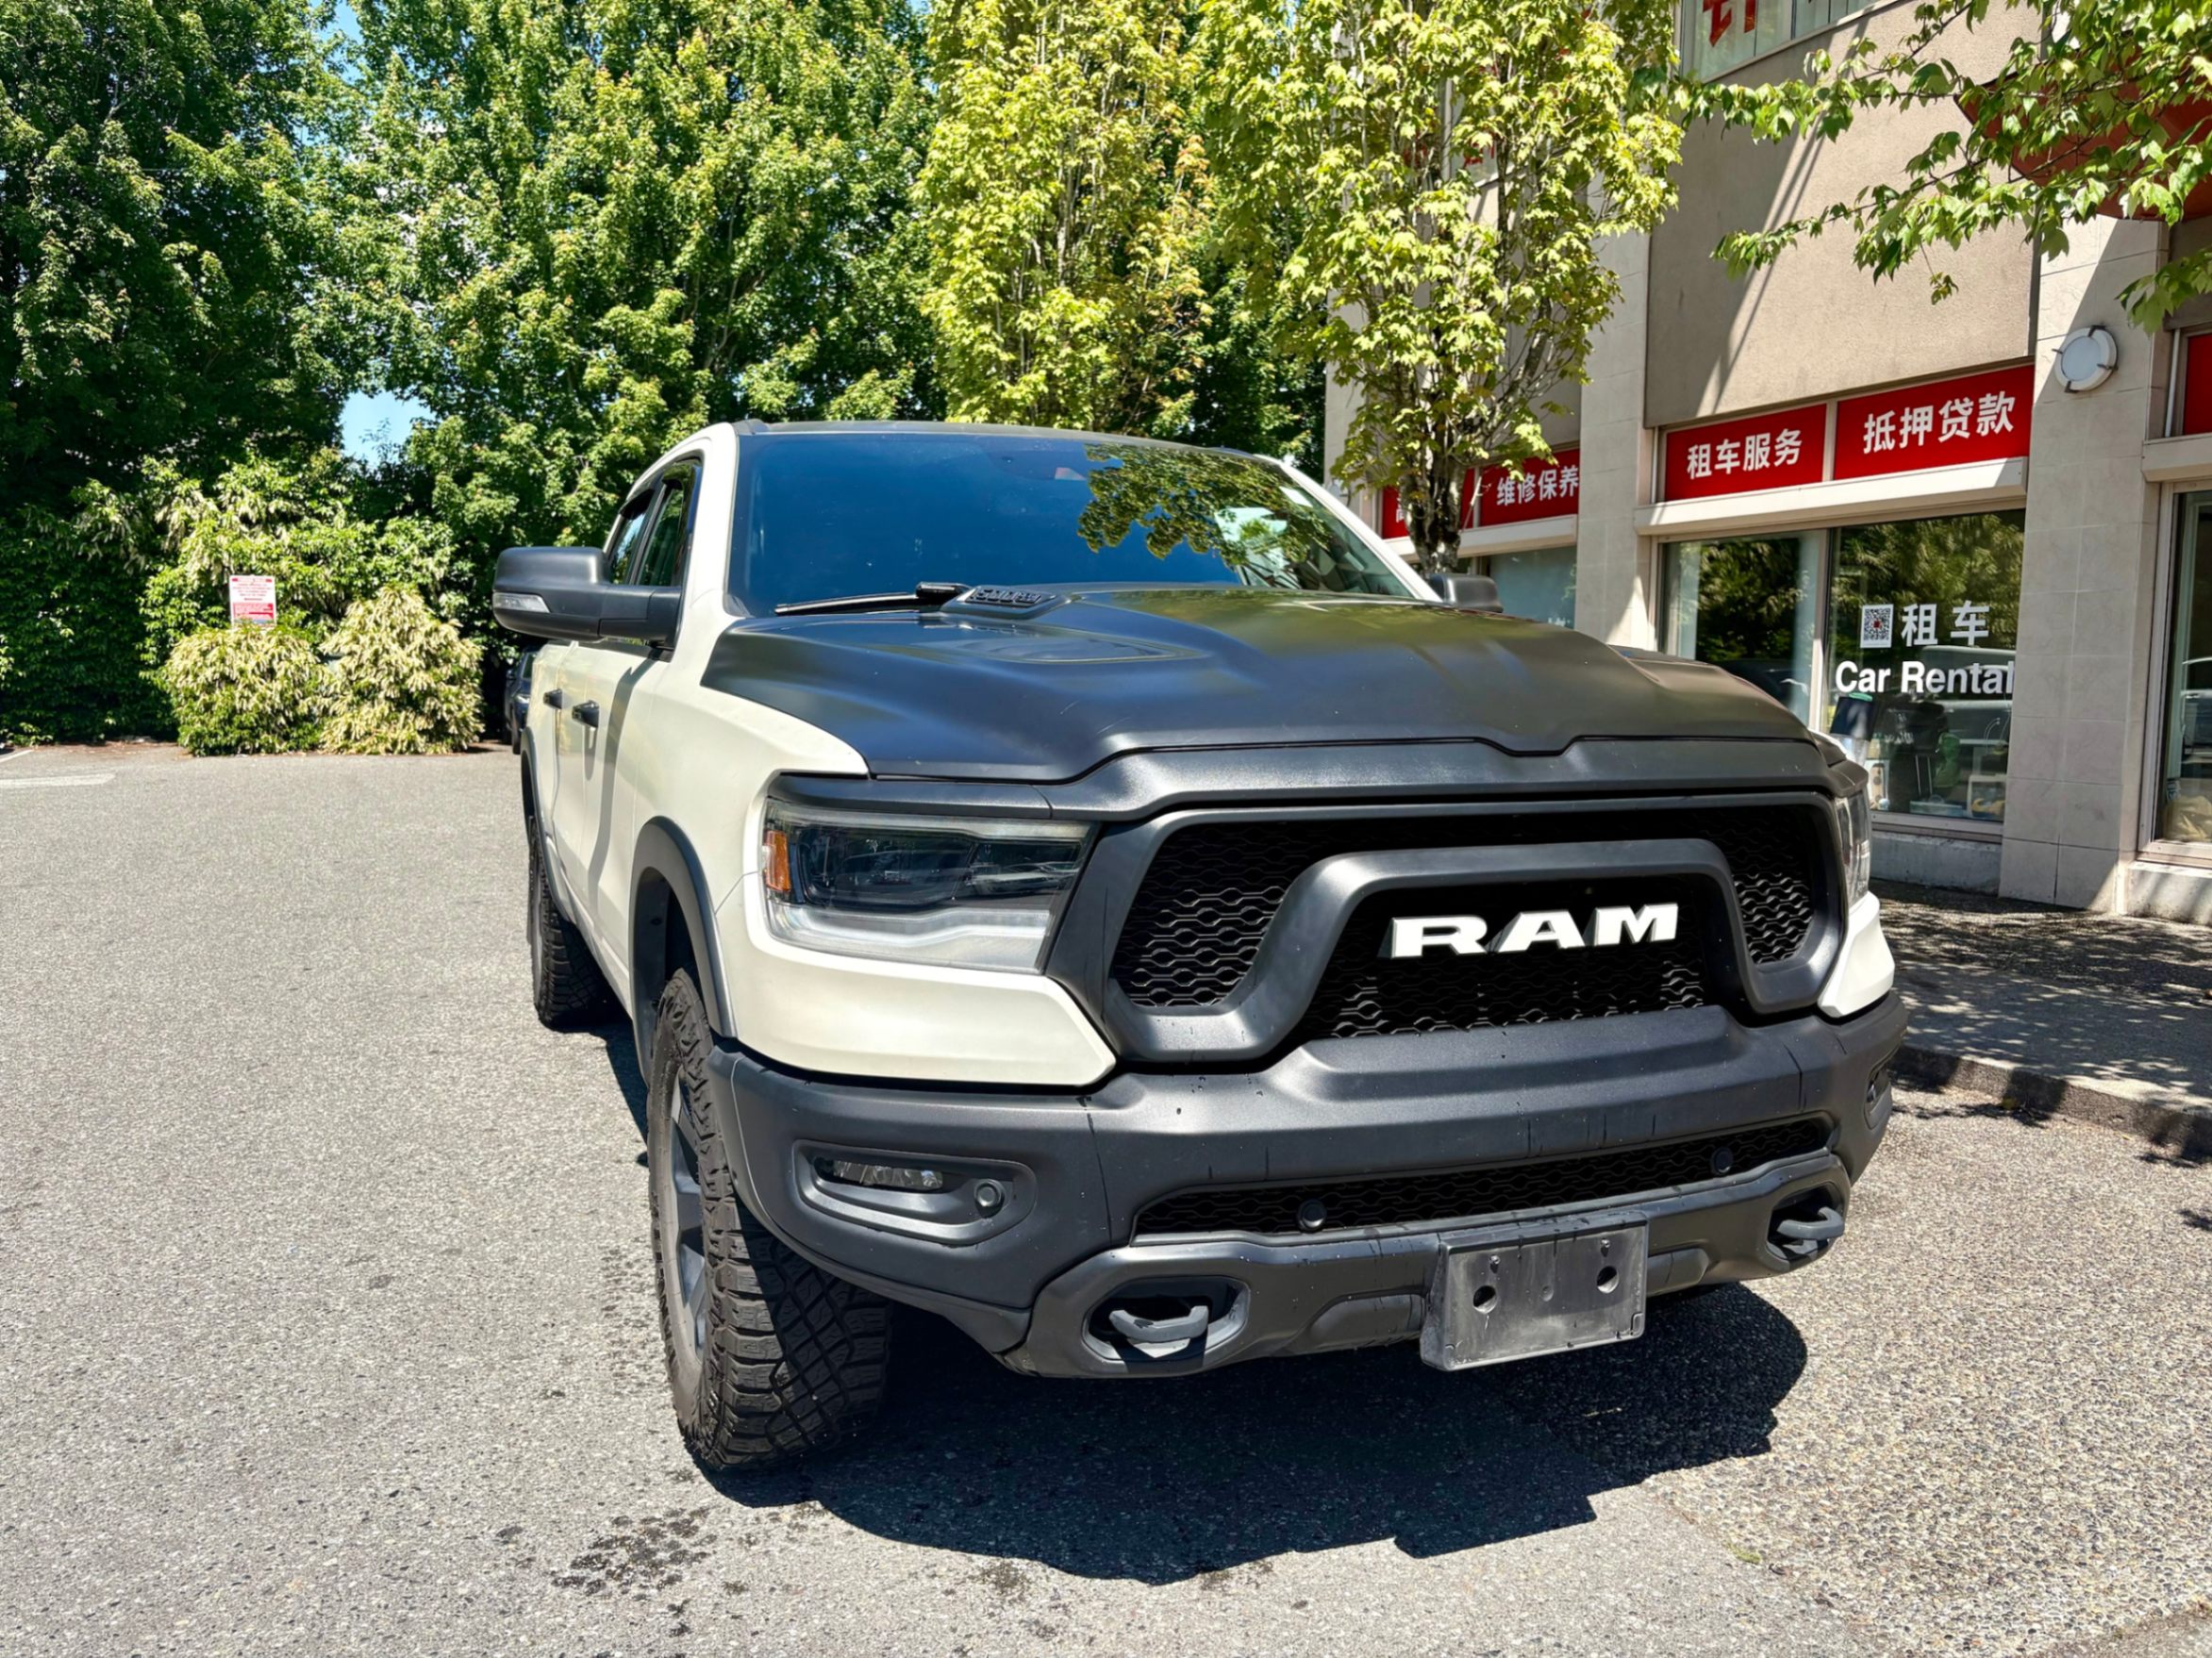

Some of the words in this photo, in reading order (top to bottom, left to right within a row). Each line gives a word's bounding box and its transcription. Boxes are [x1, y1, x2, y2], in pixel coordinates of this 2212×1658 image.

[1863, 390, 2016, 455] 抵押贷款
[1687, 427, 1803, 480] 租车服务
[1496, 465, 1580, 506] 维修保养
[1901, 600, 1990, 647] 租车
[1835, 660, 1891, 693] Car
[1901, 660, 2016, 695] Rental
[1389, 903, 1679, 959] RAM
